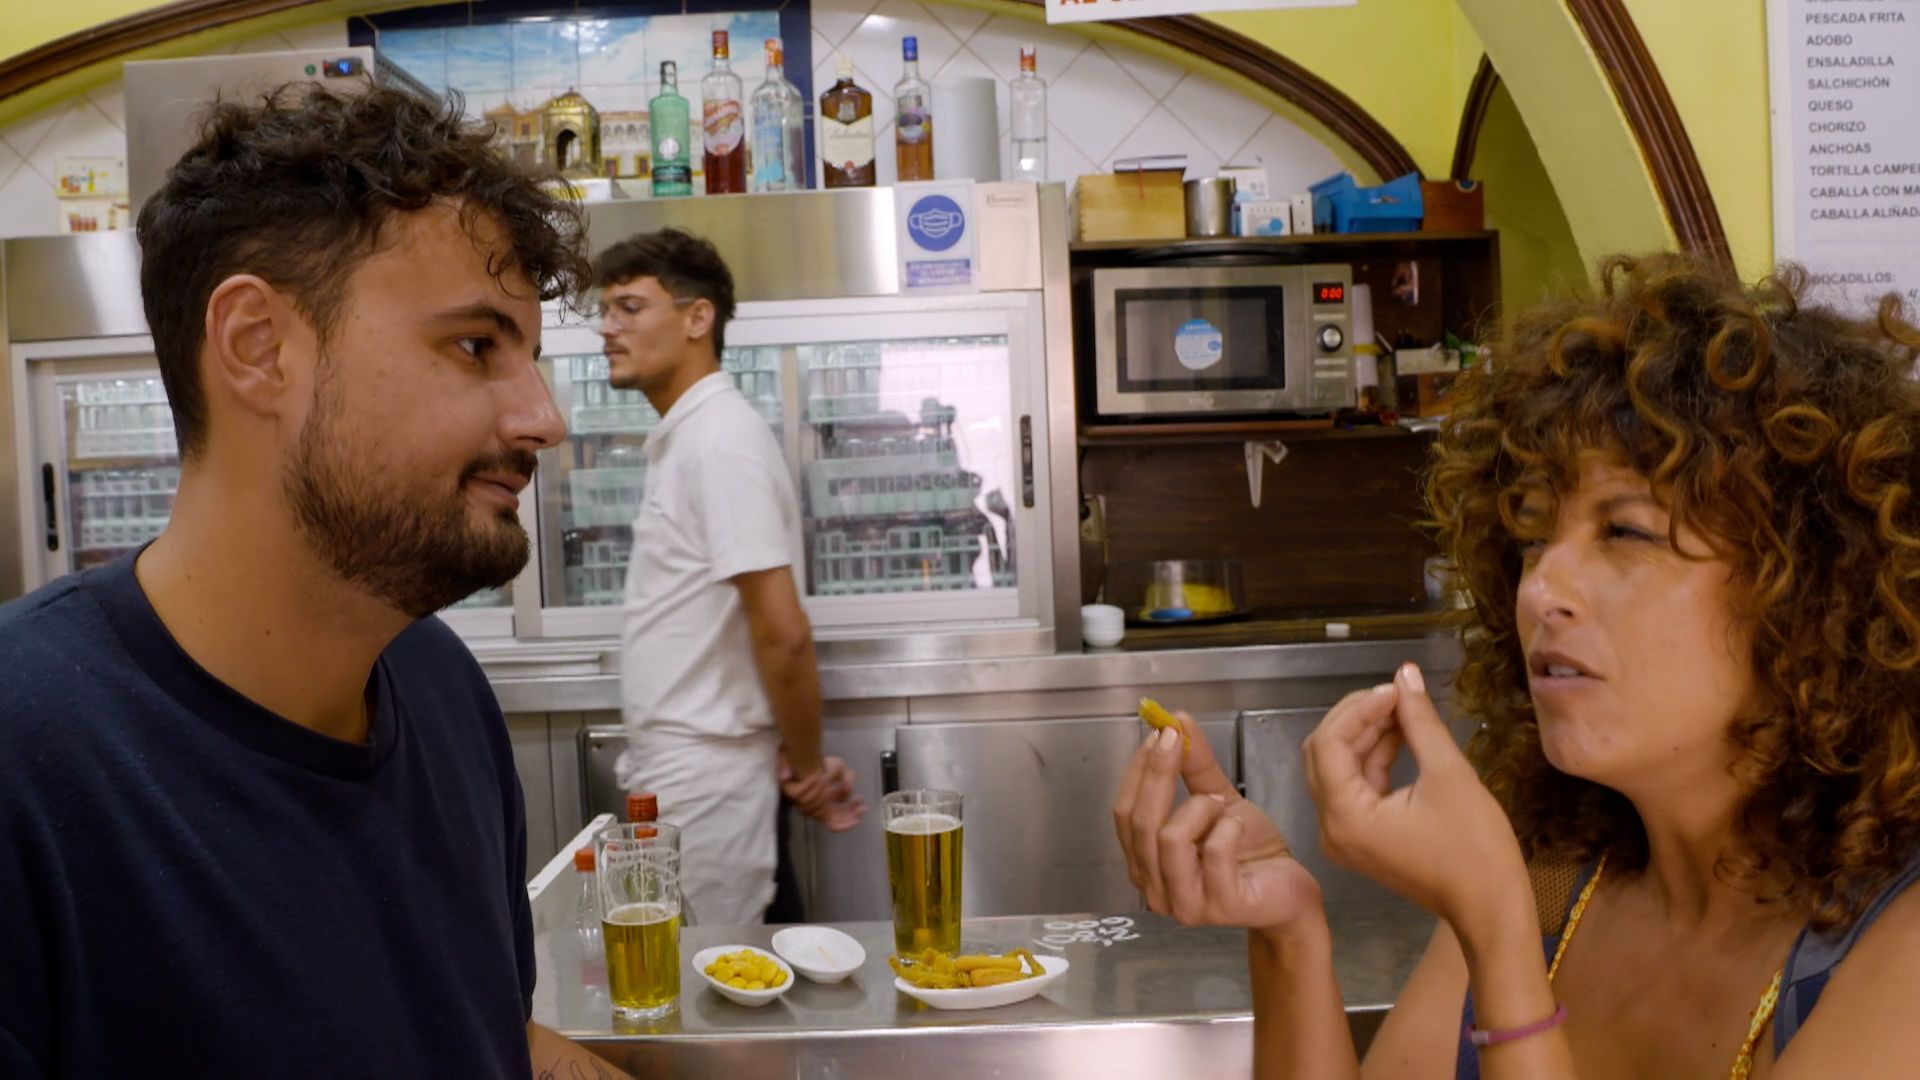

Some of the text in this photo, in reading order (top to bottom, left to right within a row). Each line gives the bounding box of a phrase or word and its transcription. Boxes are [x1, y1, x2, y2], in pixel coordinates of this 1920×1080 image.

[1806, 12, 1905, 24] PESCADA FRITA
[1806, 34, 1853, 46] ADOBO
[1807, 56, 1895, 68] ENSALADILLA
[1808, 75, 1890, 89] SALCHICHÓN
[1808, 99, 1853, 111] QUESO
[1808, 121, 1866, 133] CHORIZO
[1809, 142, 1871, 155] ANCHOAS
[1810, 163, 1920, 176] TORTILLA CAMPE
[1810, 186, 1869, 198] CABALLA
[1872, 185, 1899, 196] CON
[1811, 204, 1920, 220] CABALLA ALIÑAD
